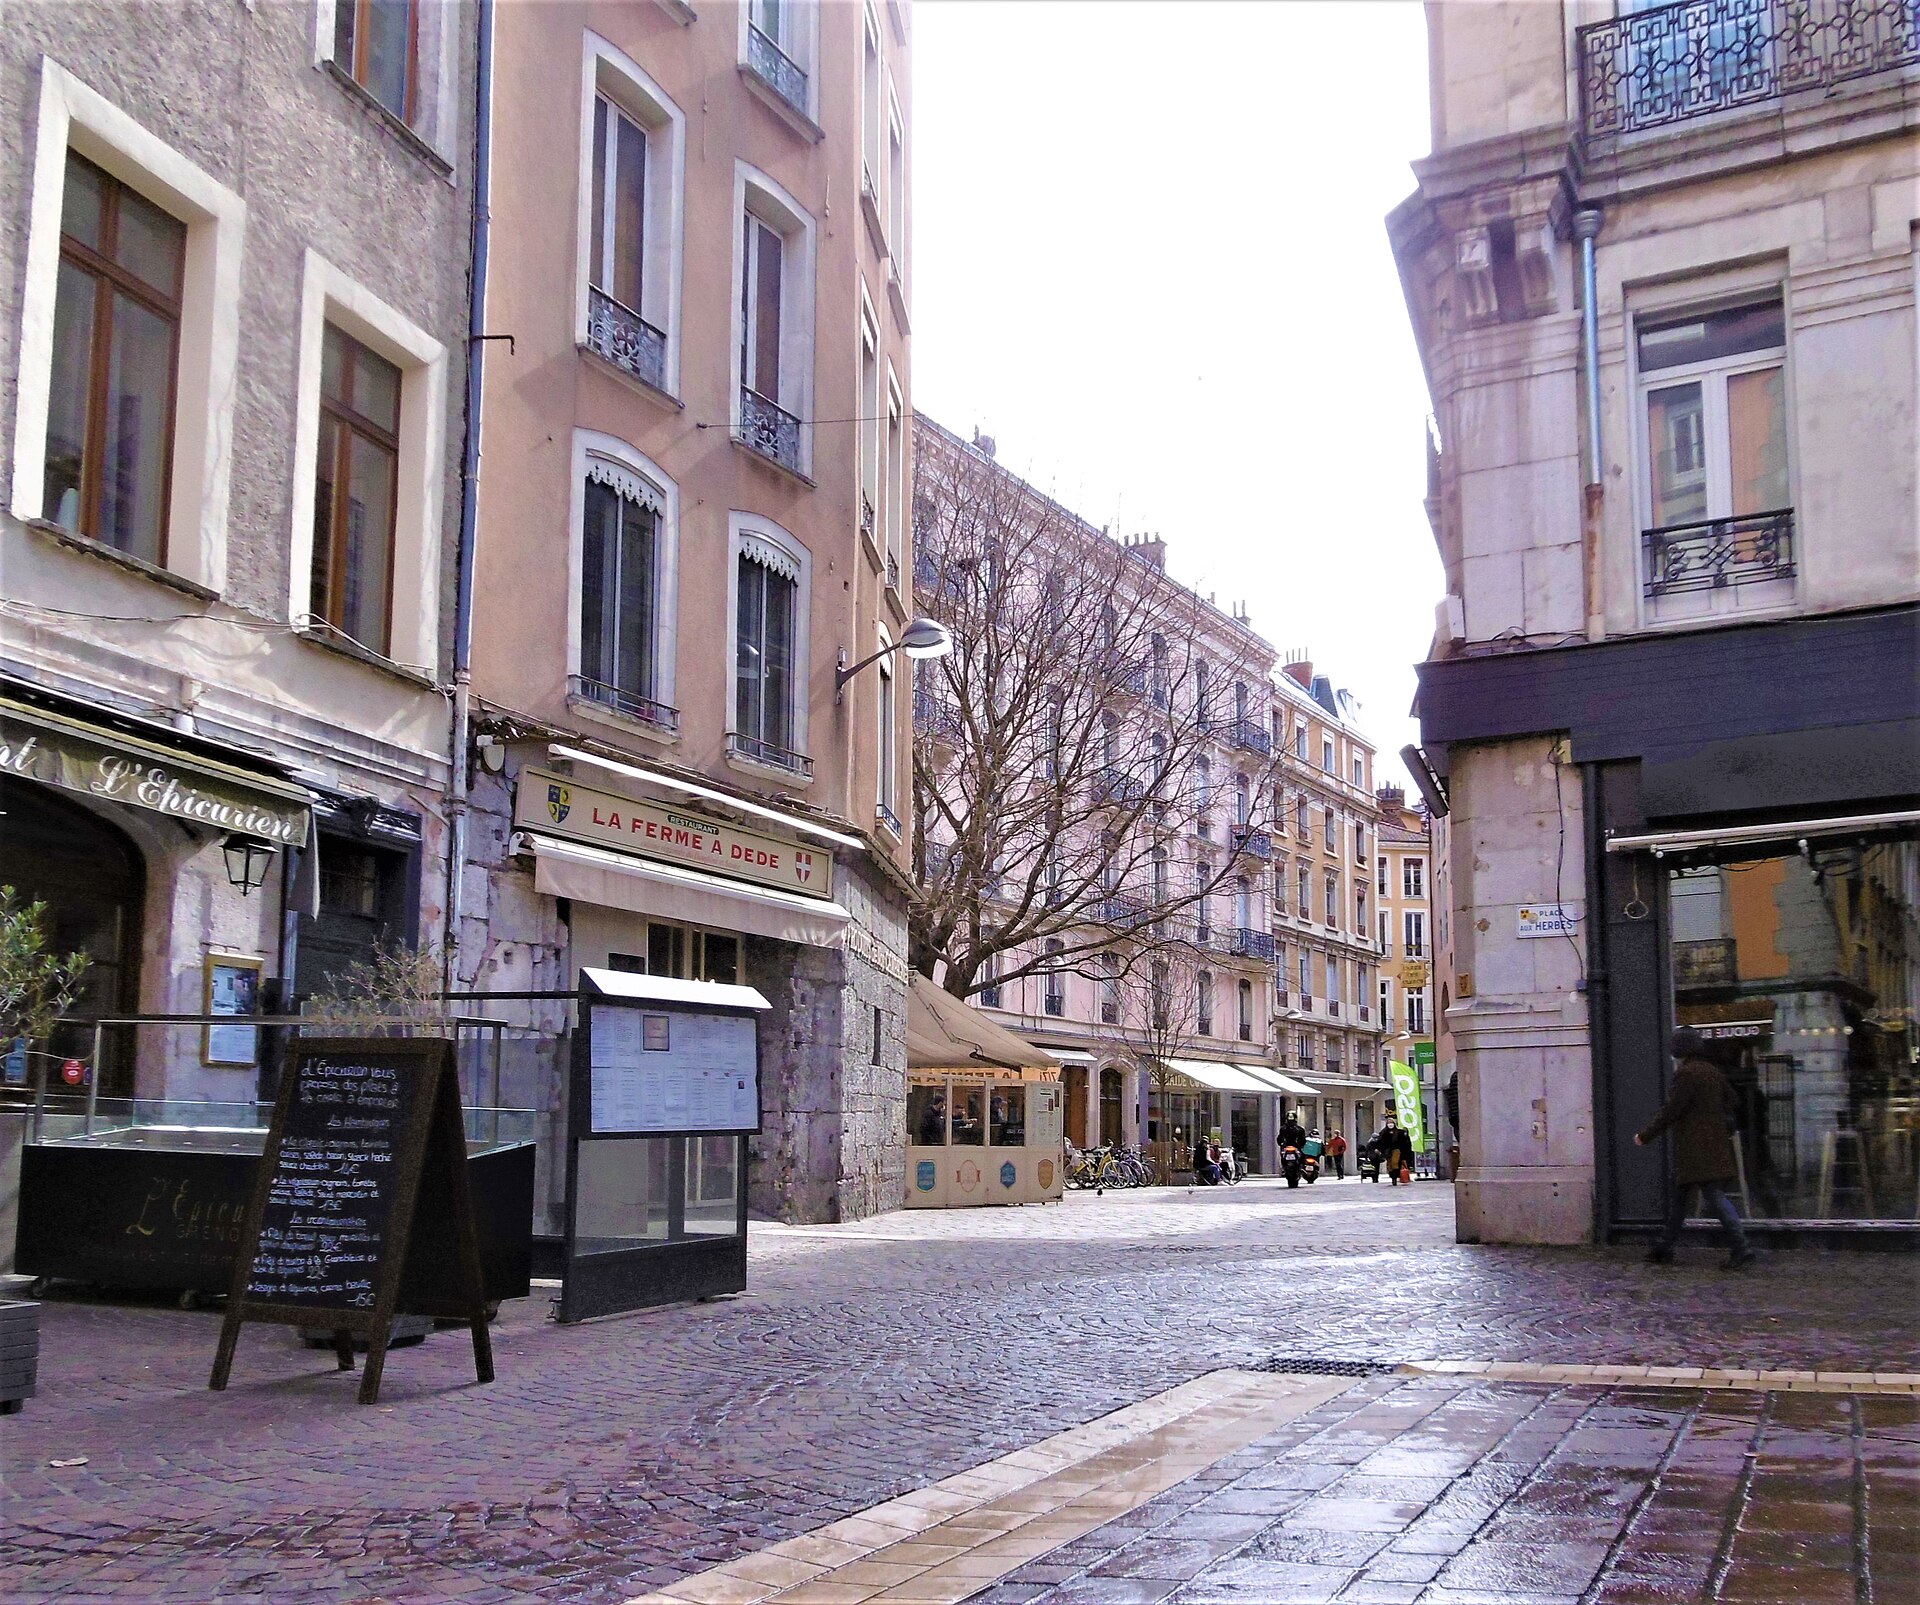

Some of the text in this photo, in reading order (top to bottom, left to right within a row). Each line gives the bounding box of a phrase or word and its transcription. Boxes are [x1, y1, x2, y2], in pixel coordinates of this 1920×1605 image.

[89, 754, 294, 842] L'Epicurien
[593, 807, 622, 830] LA
[631, 818, 703, 850] FERME
[711, 840, 722, 856] A
[731, 844, 780, 869] DEDE
[669, 815, 718, 835] RESTAURANT
[1535, 920, 1573, 931] HERBES
